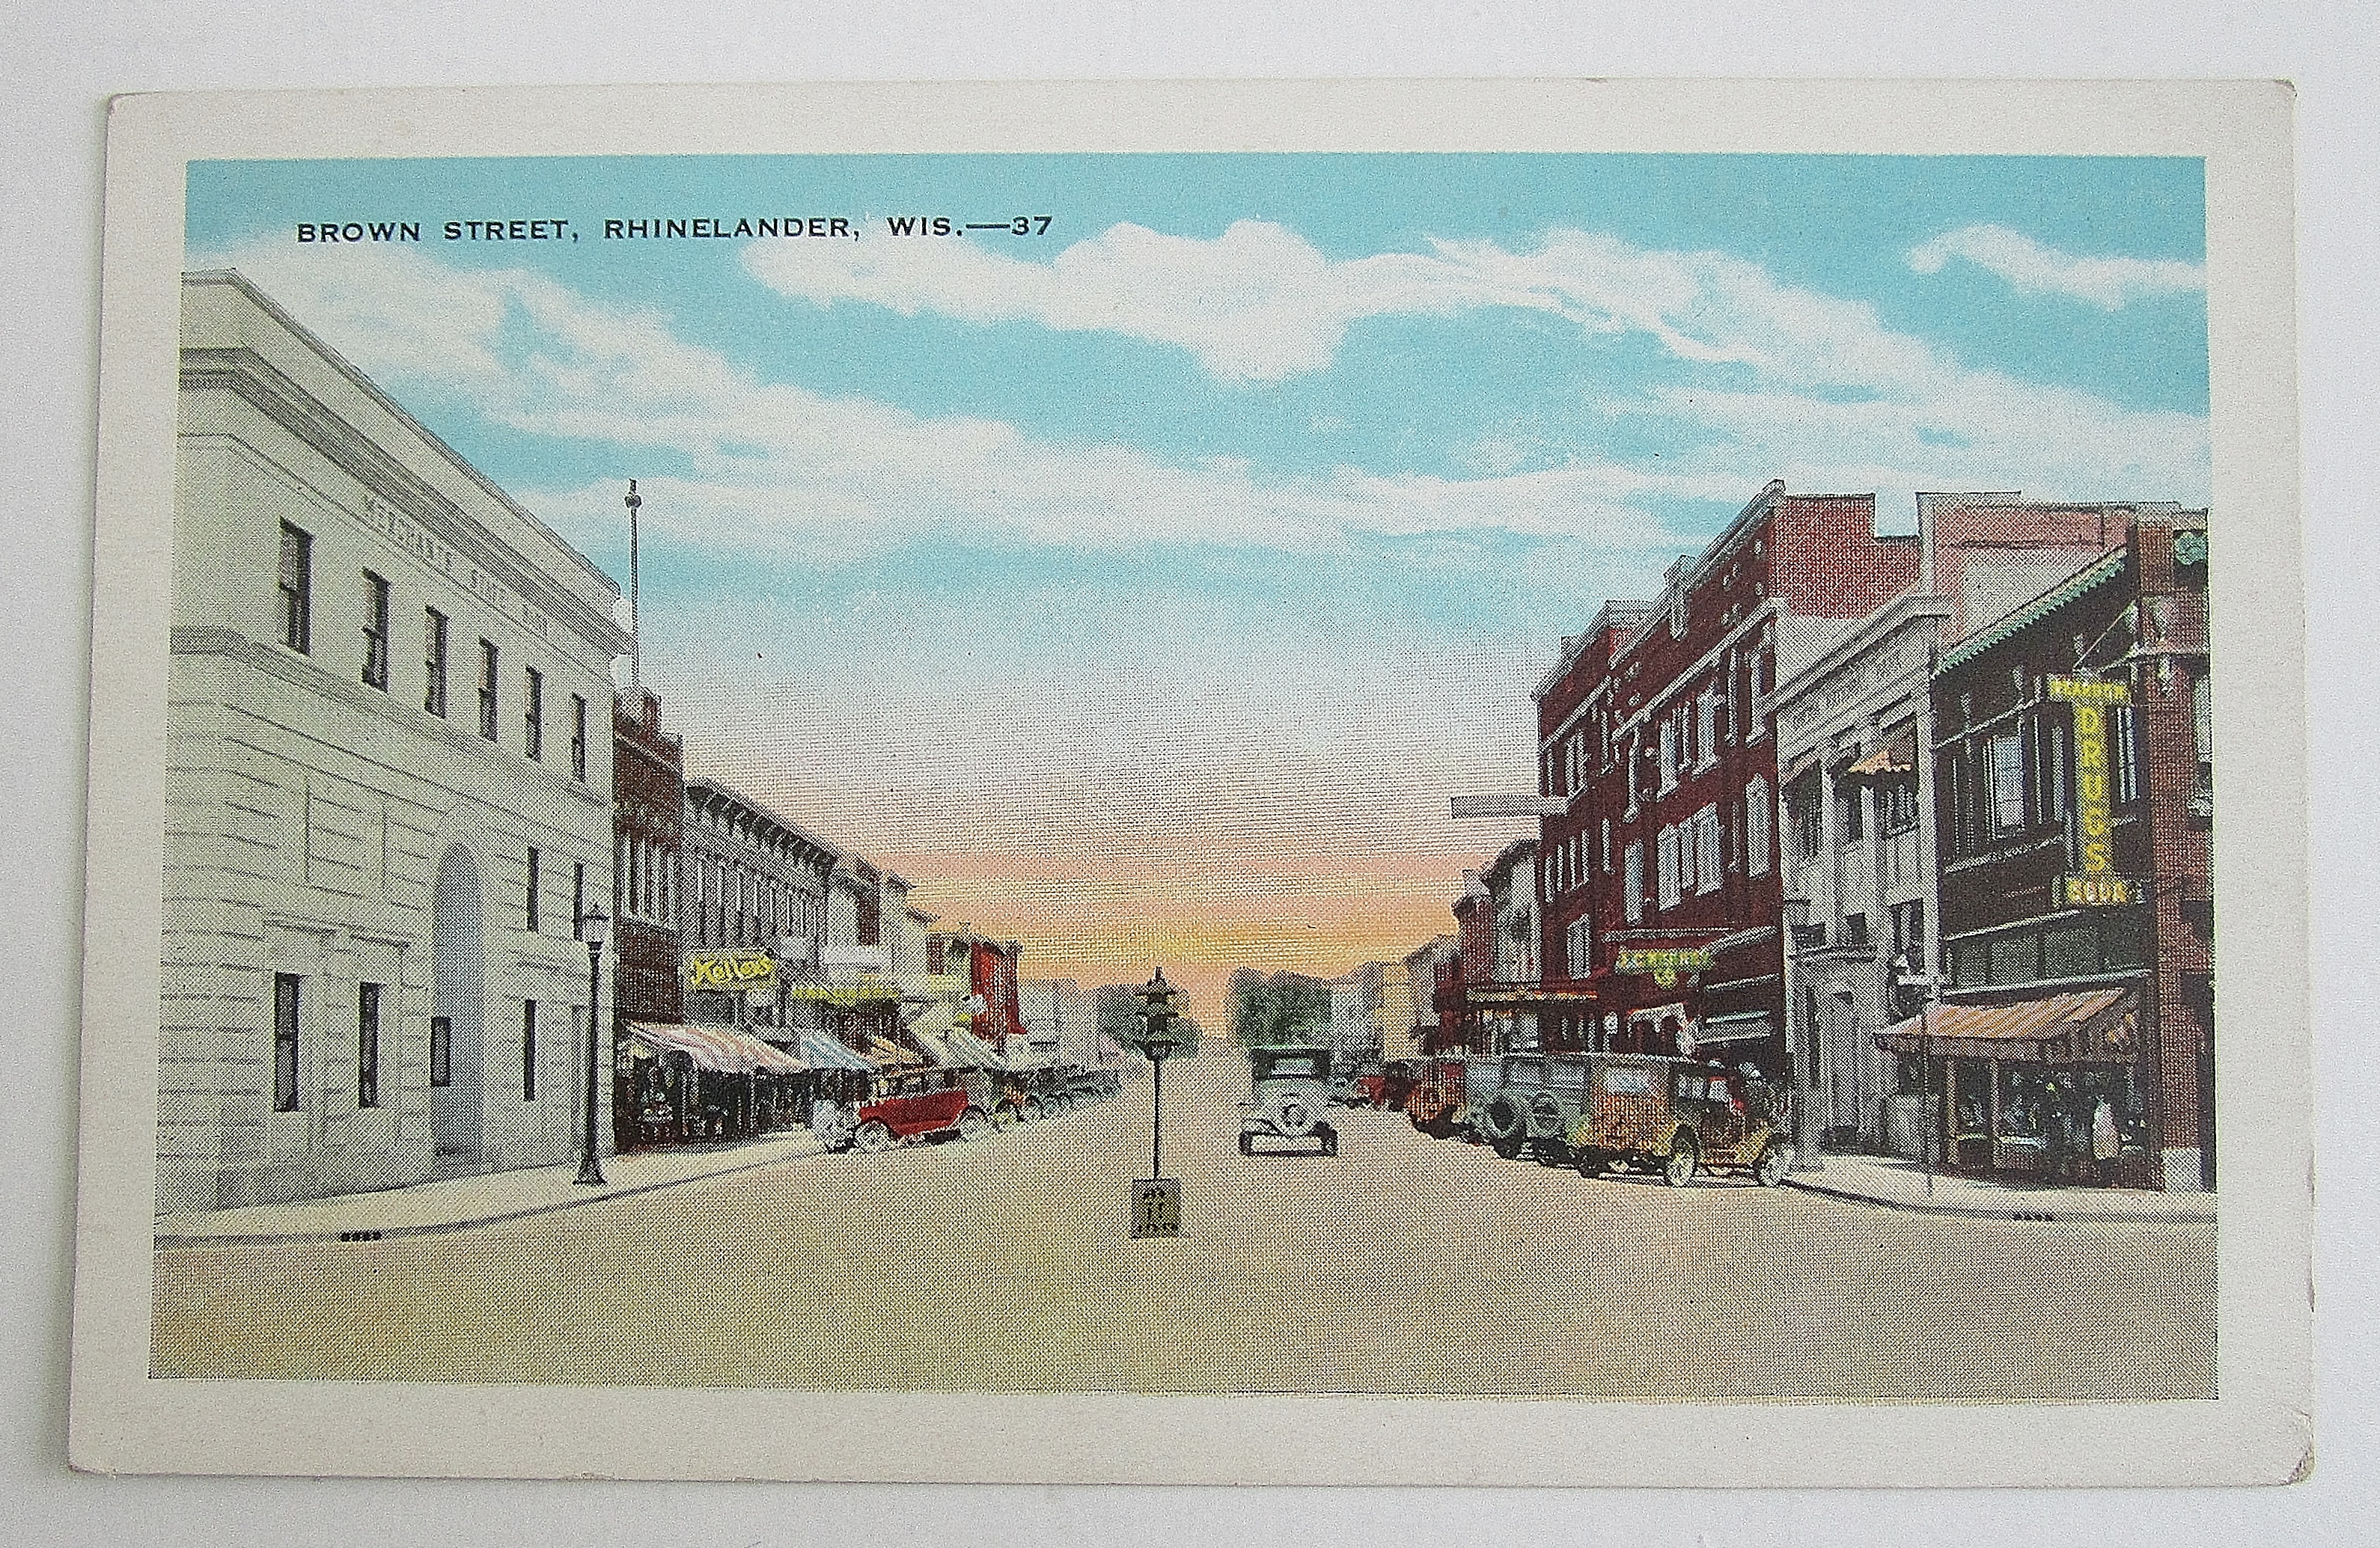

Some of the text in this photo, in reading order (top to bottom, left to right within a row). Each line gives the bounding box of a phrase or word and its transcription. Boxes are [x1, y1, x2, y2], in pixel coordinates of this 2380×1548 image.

[298, 223, 421, 243] BROWN
[444, 220, 580, 243] STREET,
[604, 218, 861, 242] RHINELANDER,
[2080, 706, 2107, 873] DRUGS
[2067, 879, 2128, 903] SODA
